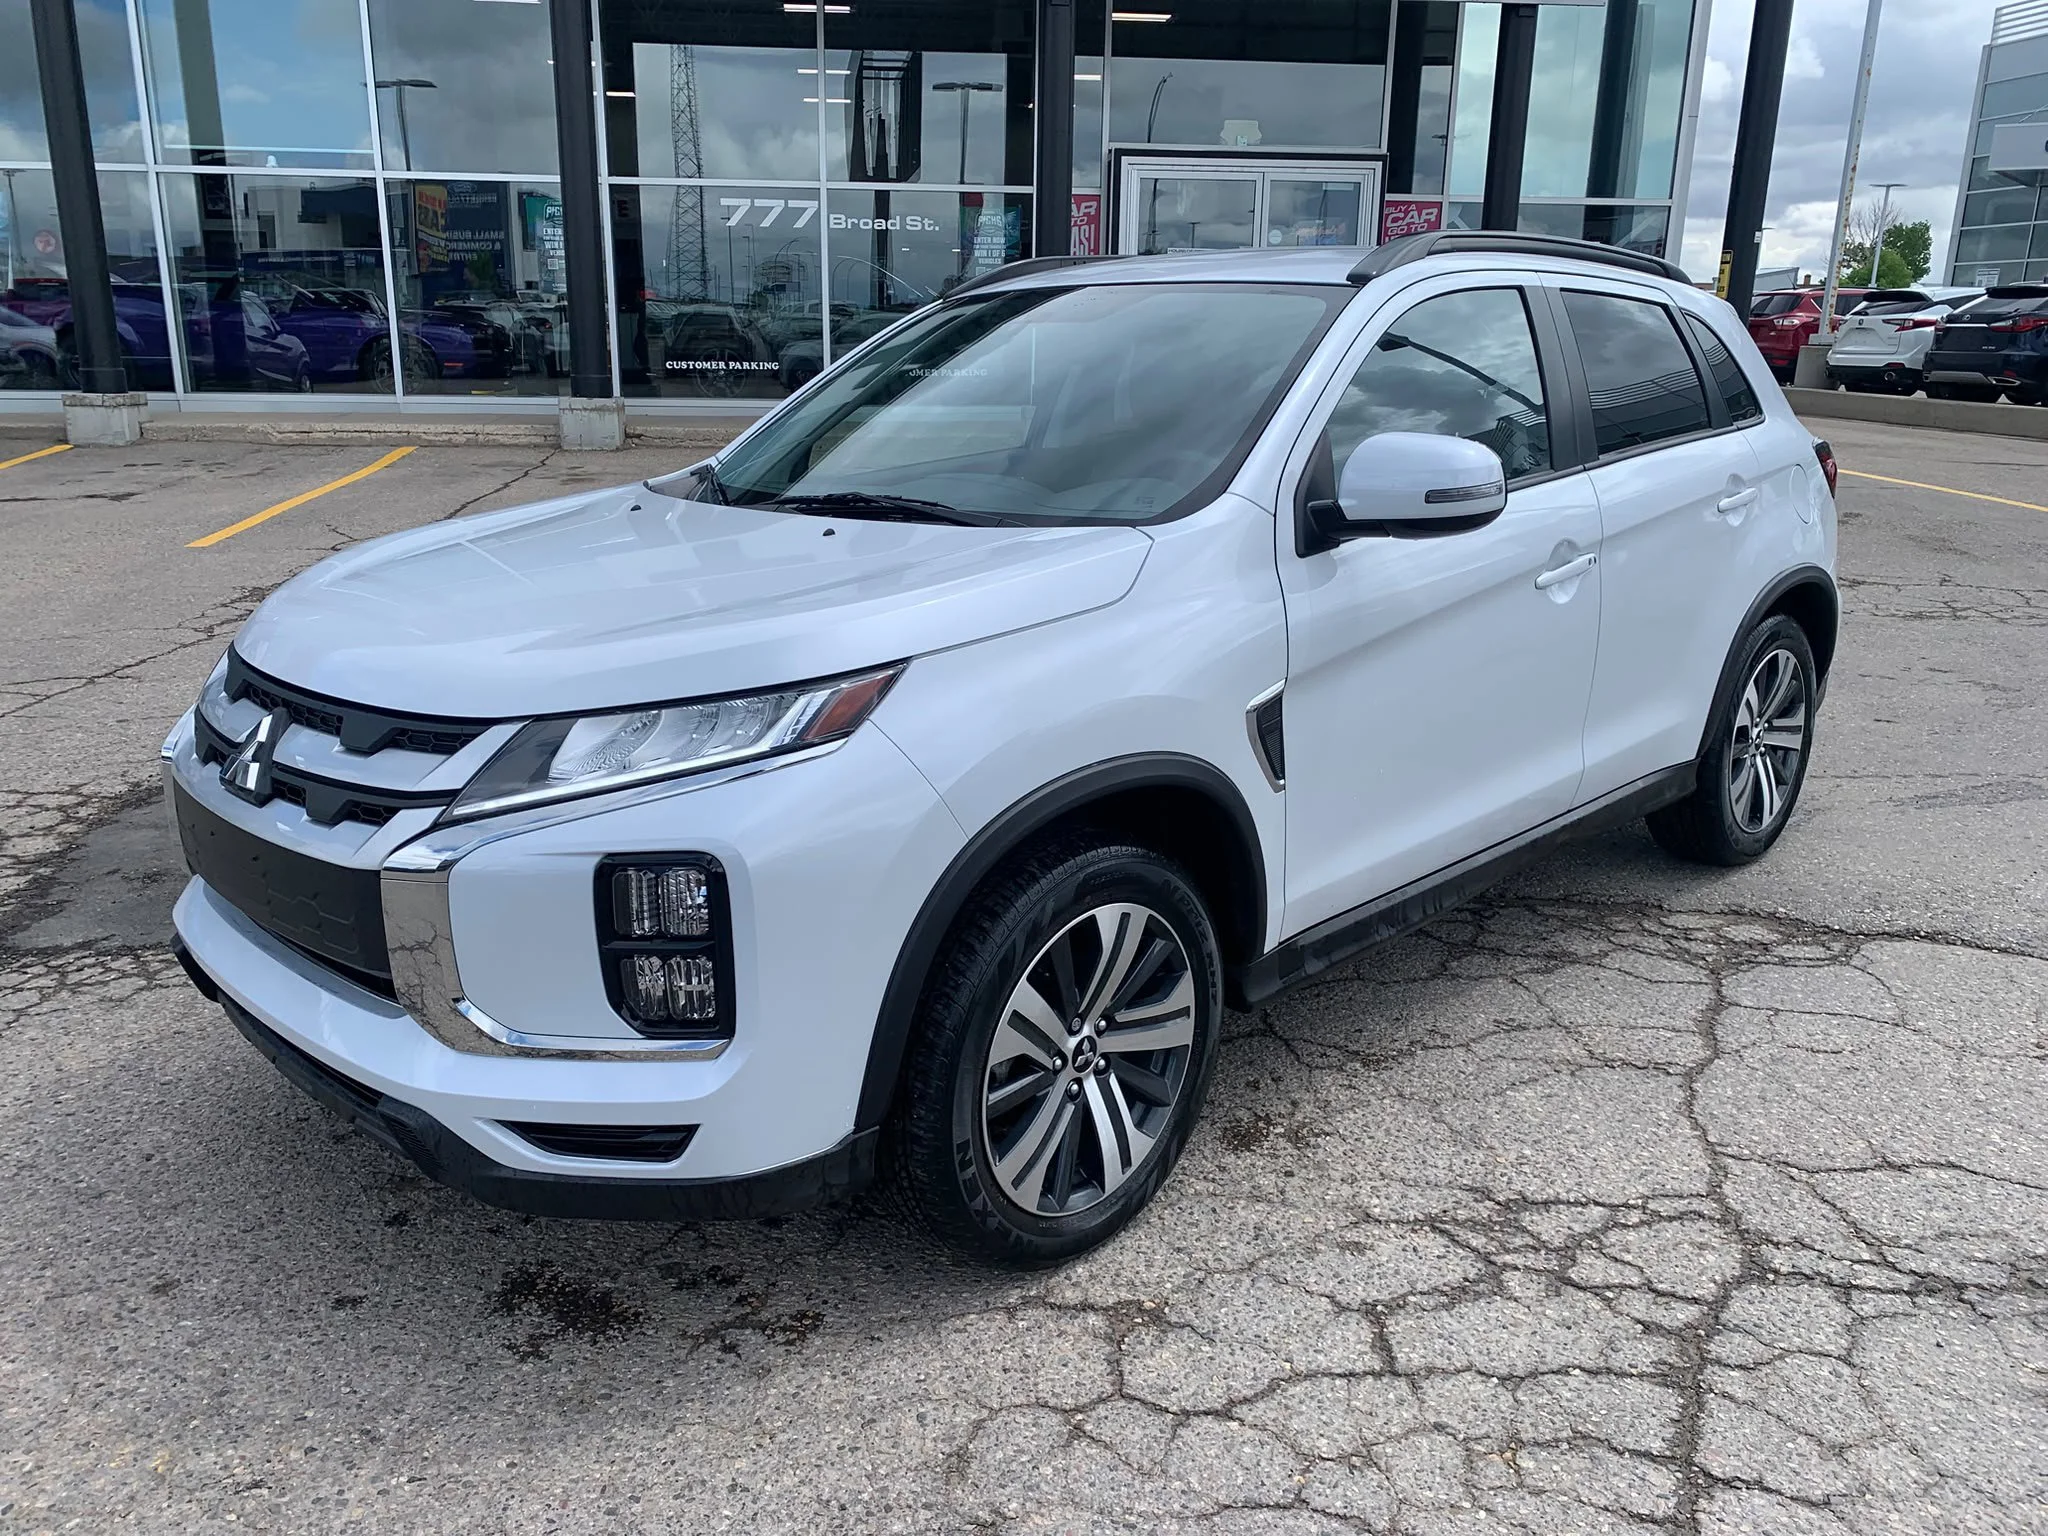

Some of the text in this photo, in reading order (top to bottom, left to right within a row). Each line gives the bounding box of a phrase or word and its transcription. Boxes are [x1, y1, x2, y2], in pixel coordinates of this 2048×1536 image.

[720, 198, 940, 231] 777 Broad St.
[1386, 207, 1438, 227] CAR
[1388, 223, 1428, 235] GO TO
[975, 249, 987, 257] WIN
[665, 360, 780, 370] CUSTOMER PARKING
[940, 368, 988, 377] PARKING
